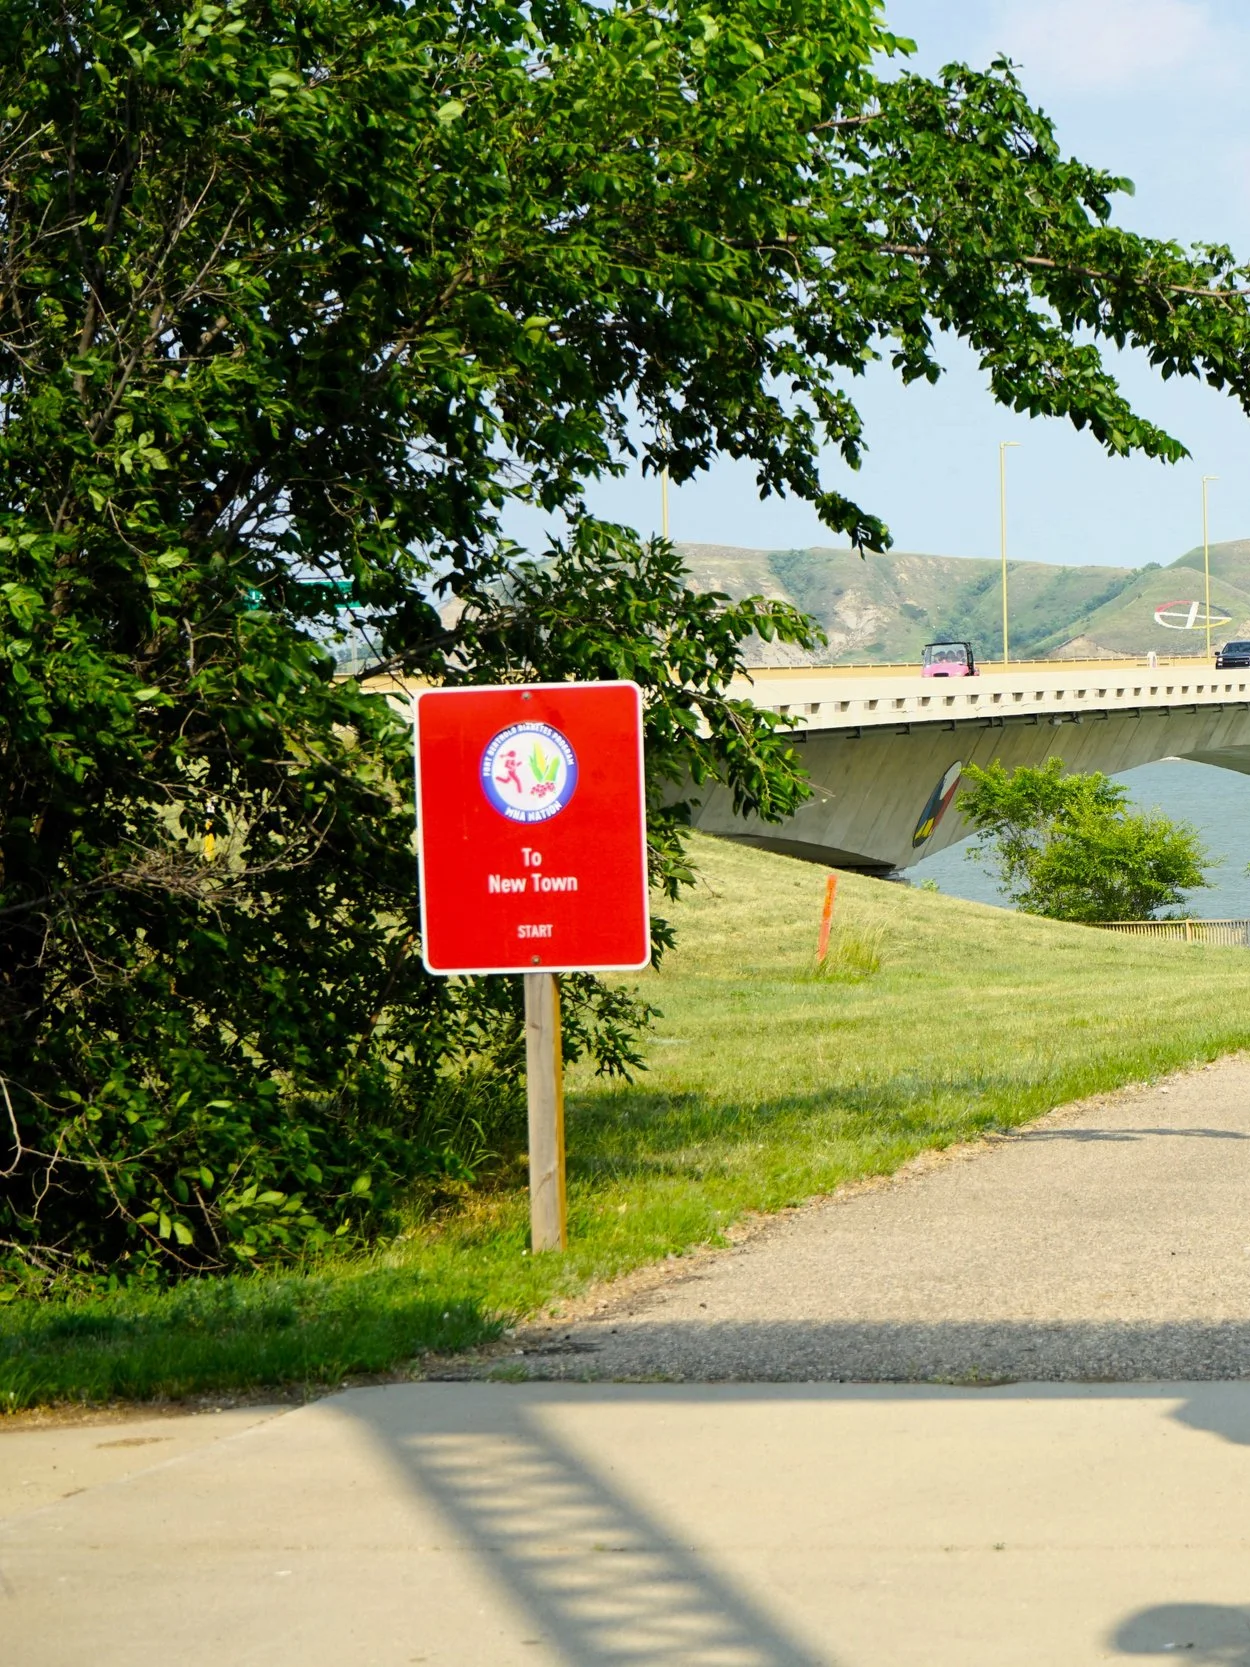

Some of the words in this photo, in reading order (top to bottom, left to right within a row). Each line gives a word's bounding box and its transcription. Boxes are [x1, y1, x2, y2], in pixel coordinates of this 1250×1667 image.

[517, 723, 553, 736] DIABETES
[486, 726, 517, 756] BERTHOLD
[551, 731, 575, 766] PROGRAM
[482, 755, 492, 777] FORT
[527, 800, 563, 822] NATION
[521, 847, 542, 867] To
[488, 873, 527, 894] New
[531, 872, 578, 893] Town
[517, 924, 554, 939] START
